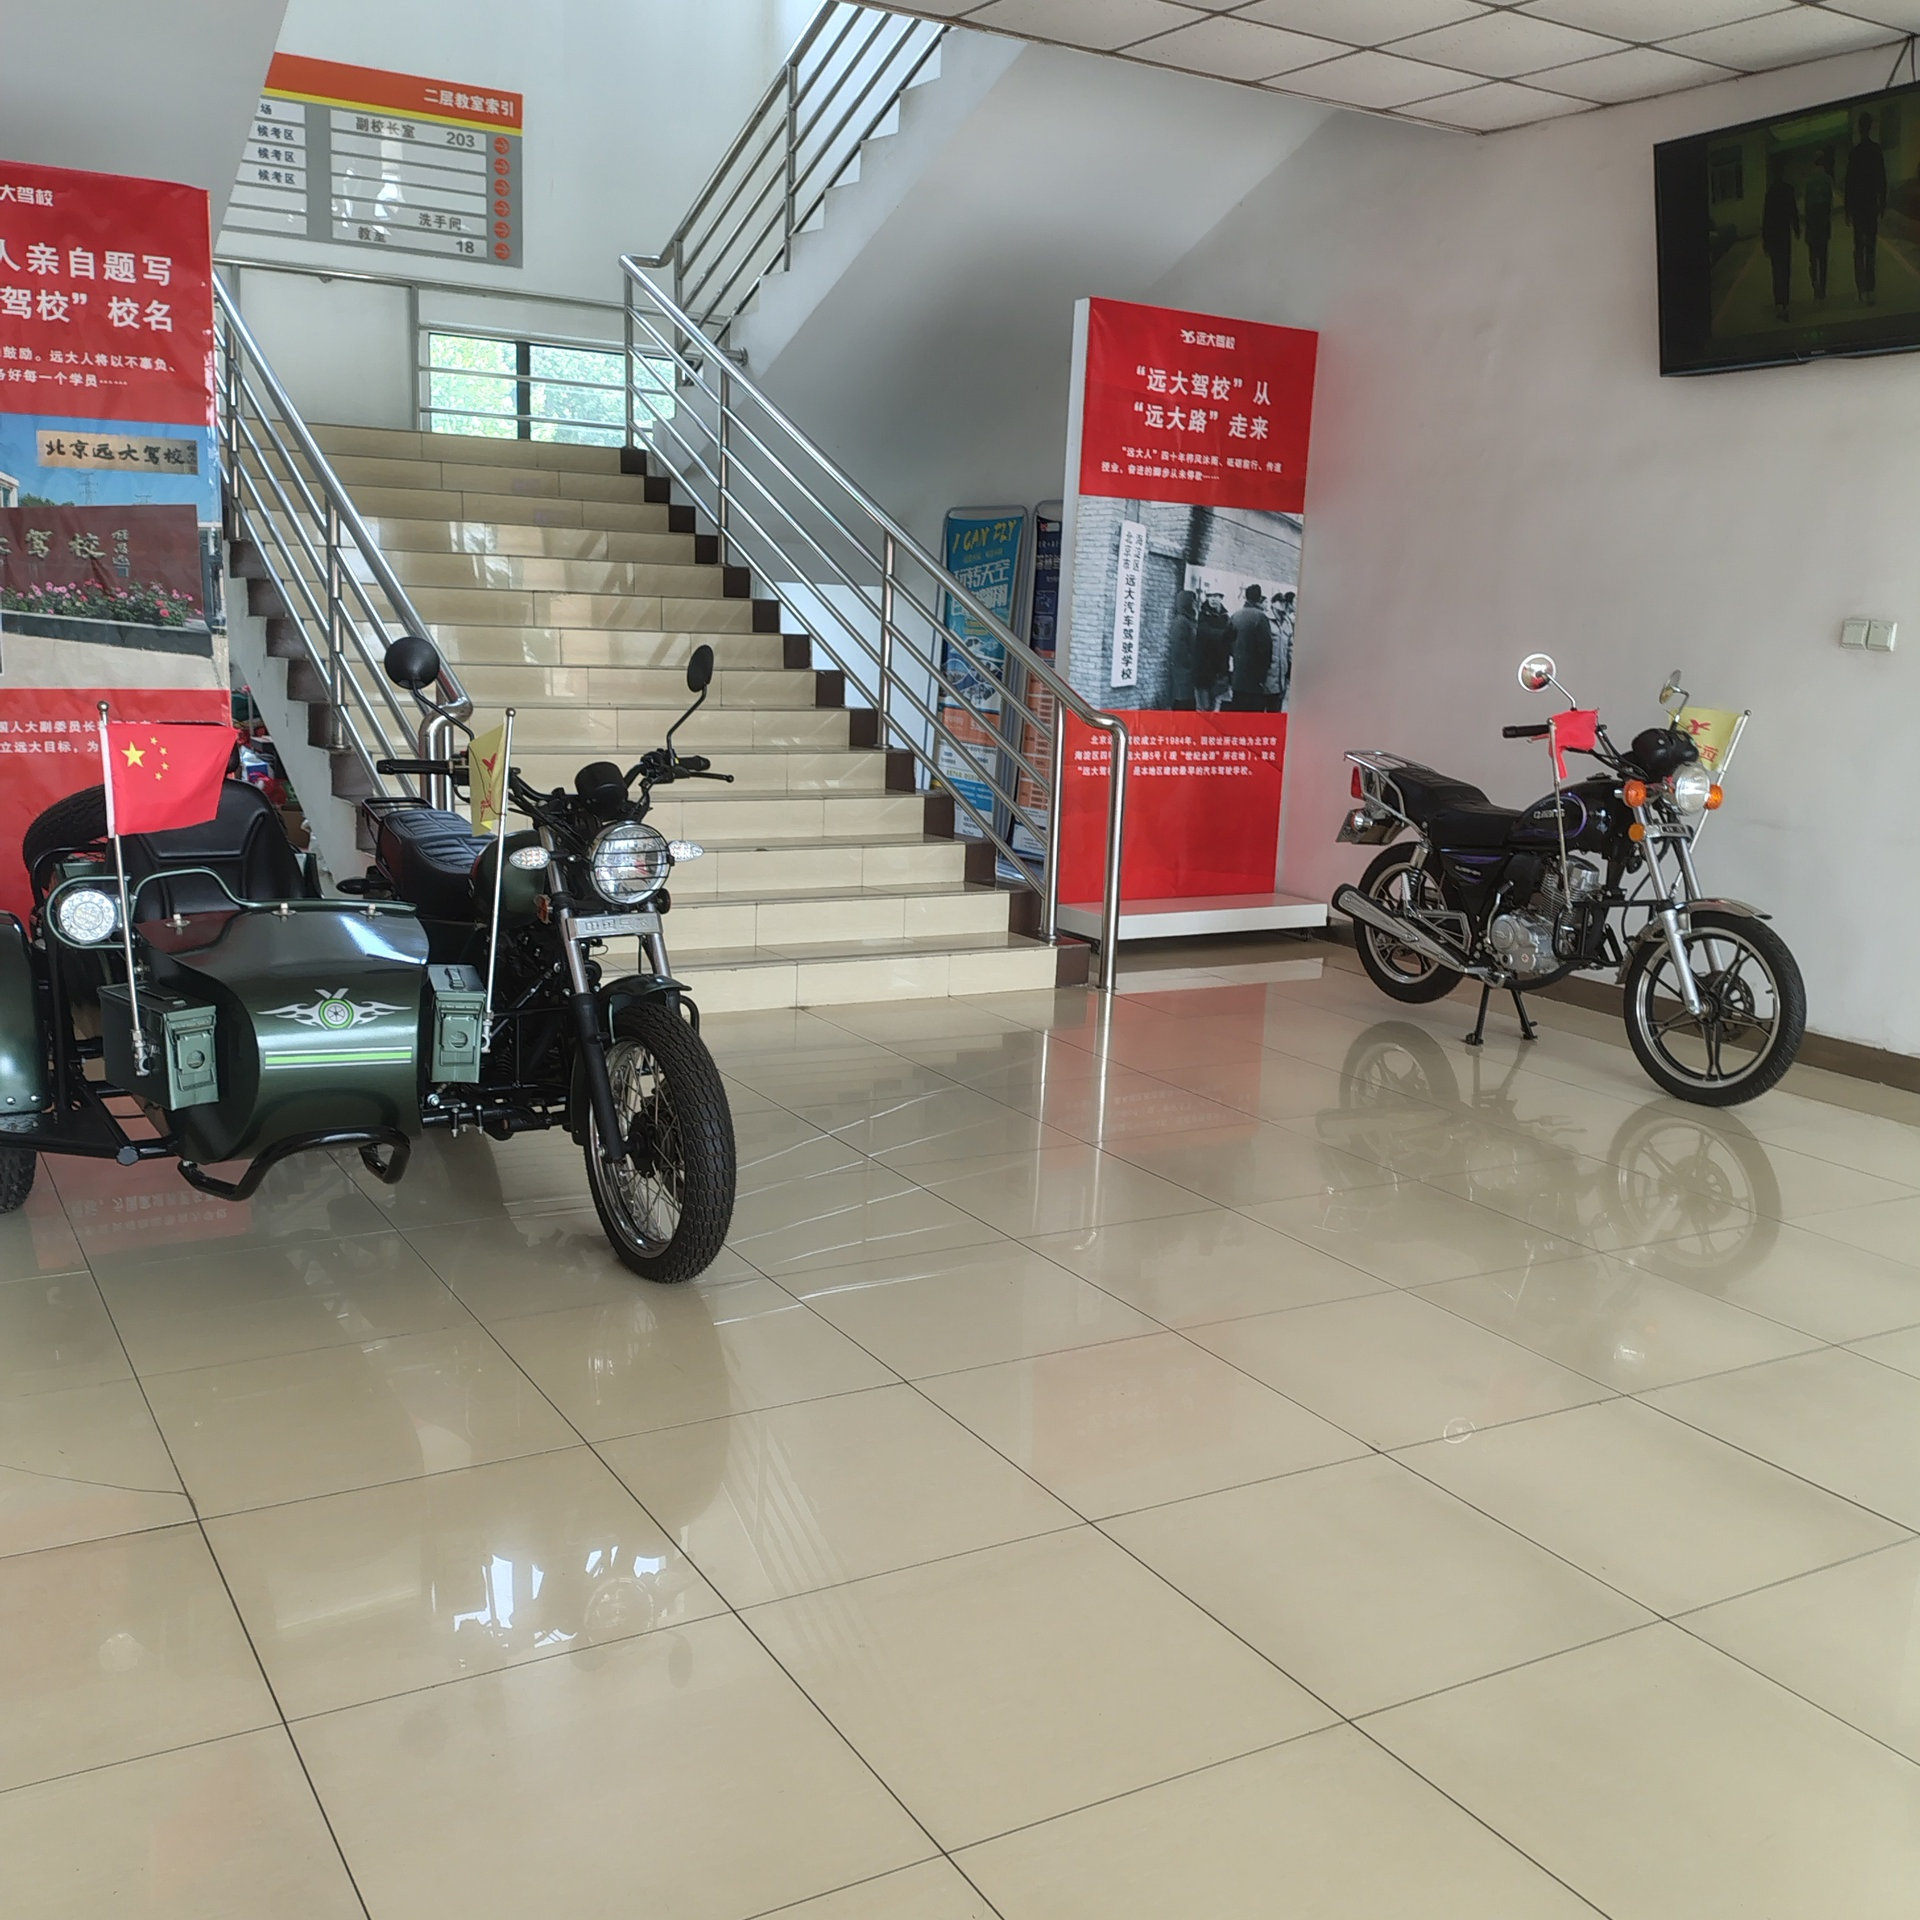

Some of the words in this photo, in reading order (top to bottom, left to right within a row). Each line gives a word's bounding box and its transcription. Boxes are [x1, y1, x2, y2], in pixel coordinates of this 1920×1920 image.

[260, 103, 272, 115] 场
[423, 88, 514, 118] 二层教室索引
[257, 124, 295, 142] 候考区
[356, 116, 416, 140] 副校长室
[446, 131, 475, 148] 203
[258, 146, 296, 164] 候考区
[258, 168, 296, 185] 候考区
[0, 183, 54, 207] 大驾校
[418, 212, 462, 230] 洗手间
[357, 225, 387, 243] 教室
[456, 240, 475, 254] 18
[1196, 331, 1236, 350] 远大驾校
[45, 439, 186, 464] 北京远大驾校
[0, 528, 106, 559] 驾校
